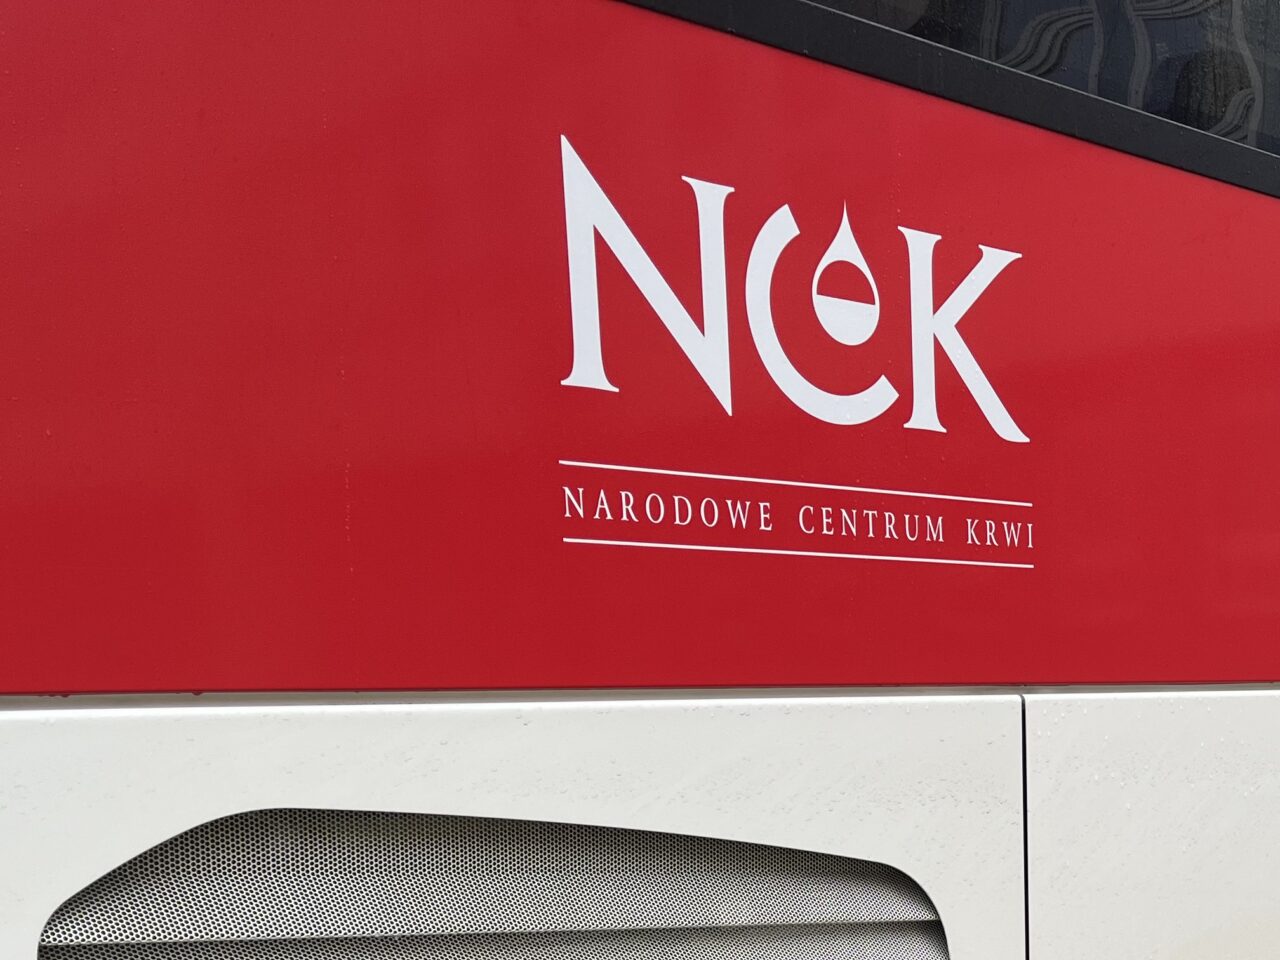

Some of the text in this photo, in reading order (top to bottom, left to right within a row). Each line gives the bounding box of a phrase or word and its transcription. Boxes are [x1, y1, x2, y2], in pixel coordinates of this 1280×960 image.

[560, 134, 1031, 443] NCK
[562, 486, 1033, 549] NARODOWE CENTRUM KRWI
